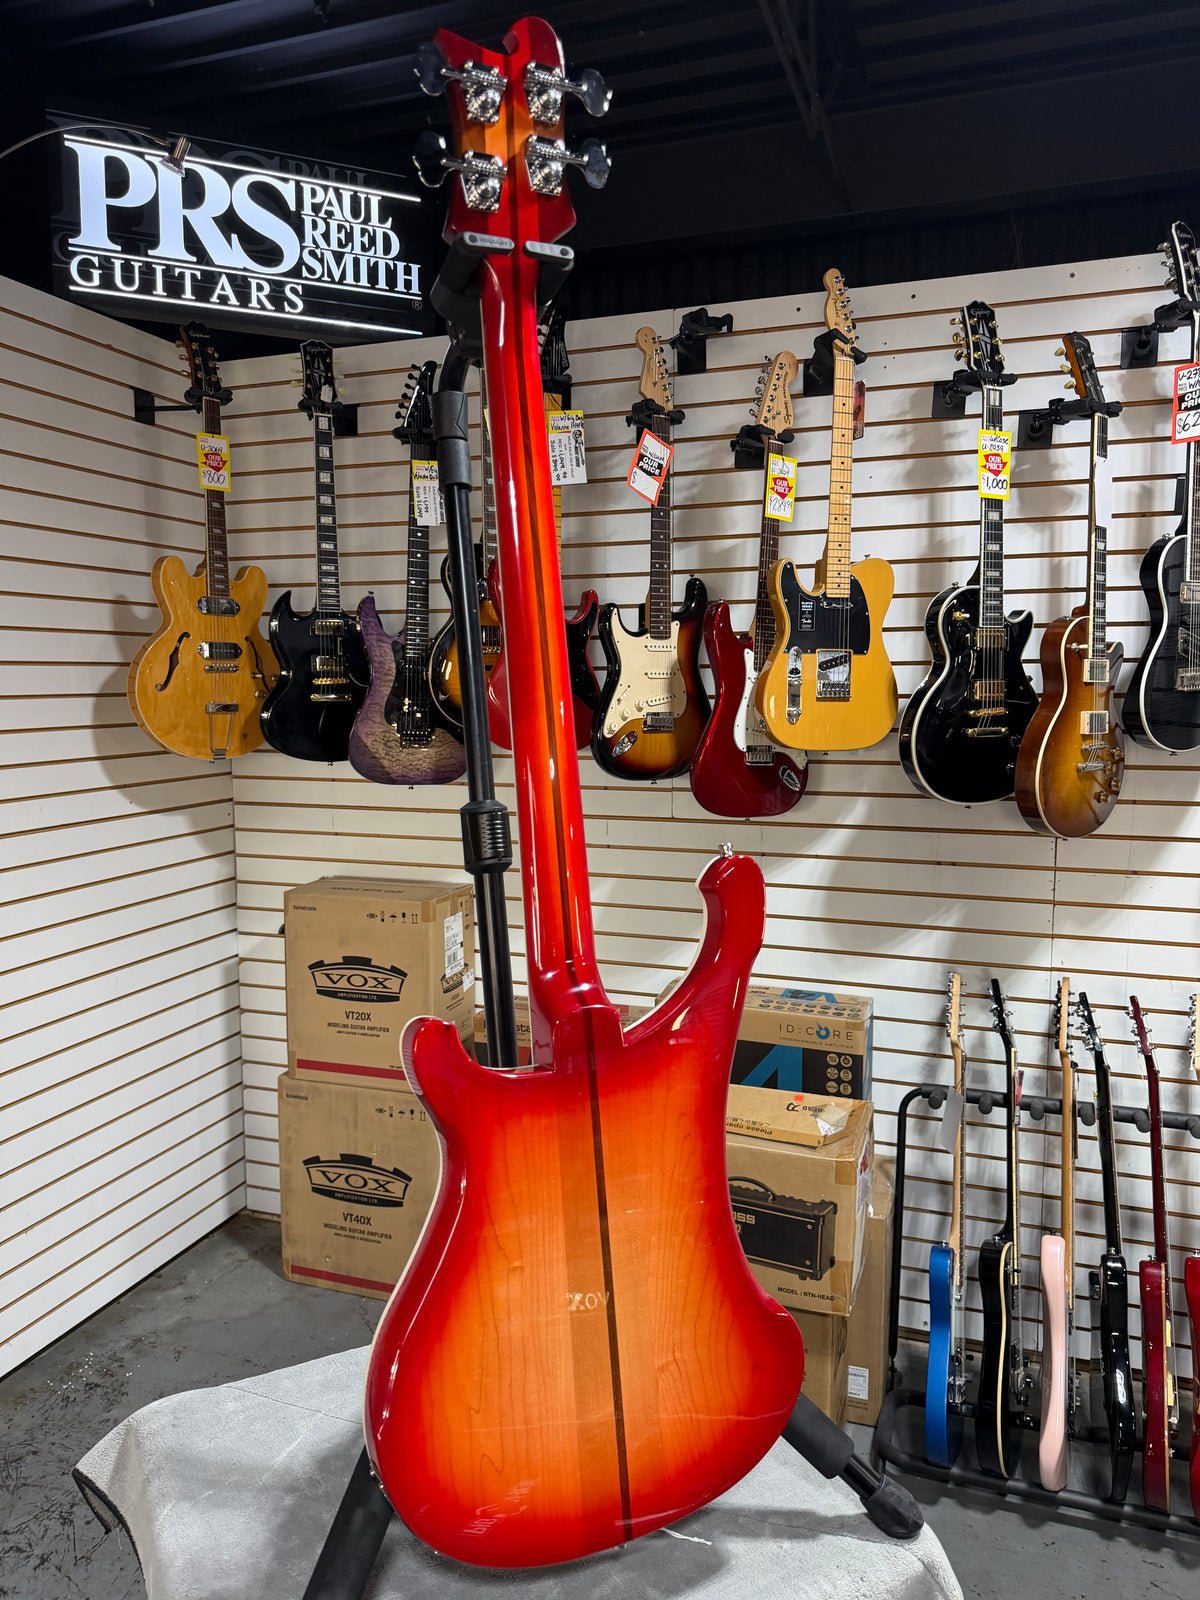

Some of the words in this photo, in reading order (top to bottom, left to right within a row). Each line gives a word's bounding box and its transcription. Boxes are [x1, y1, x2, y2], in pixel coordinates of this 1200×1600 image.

[64, 141, 301, 275] PRS
[300, 182, 393, 228] PAUL
[302, 214, 401, 259] REED
[302, 247, 422, 295] SMITH
[69, 254, 305, 314] GUITARS
[1184, 390, 1200, 401] OU
[206, 459, 224, 468] PRICE
[207, 453, 222, 462] OUR
[642, 456, 659, 469] OUR
[988, 455, 1002, 464] OUR
[638, 461, 661, 476] PRICE
[986, 462, 1004, 471] PRICE
[776, 478, 788, 488] OUR
[774, 485, 790, 495] PRICE
[320, 972, 393, 990] VOX
[337, 992, 368, 1000] AMPLIFICATION
[344, 1010, 372, 1022] VT20X
[327, 1021, 349, 1029] MODELING
[366, 1025, 390, 1033] AMPLIFIER
[779, 1036, 823, 1045] PROGRAMMABLE
[316, 1169, 395, 1194] VOX
[334, 1192, 368, 1203] AMPLIFICATION
[342, 1212, 372, 1226] VT40X
[323, 1222, 347, 1232] MODELING
[348, 1227, 366, 1235] GUITAR
[366, 1230, 392, 1240] AMPLIFIER
[777, 1286, 799, 1296] MODEL
[803, 1292, 835, 1302] KTN-HEAD
